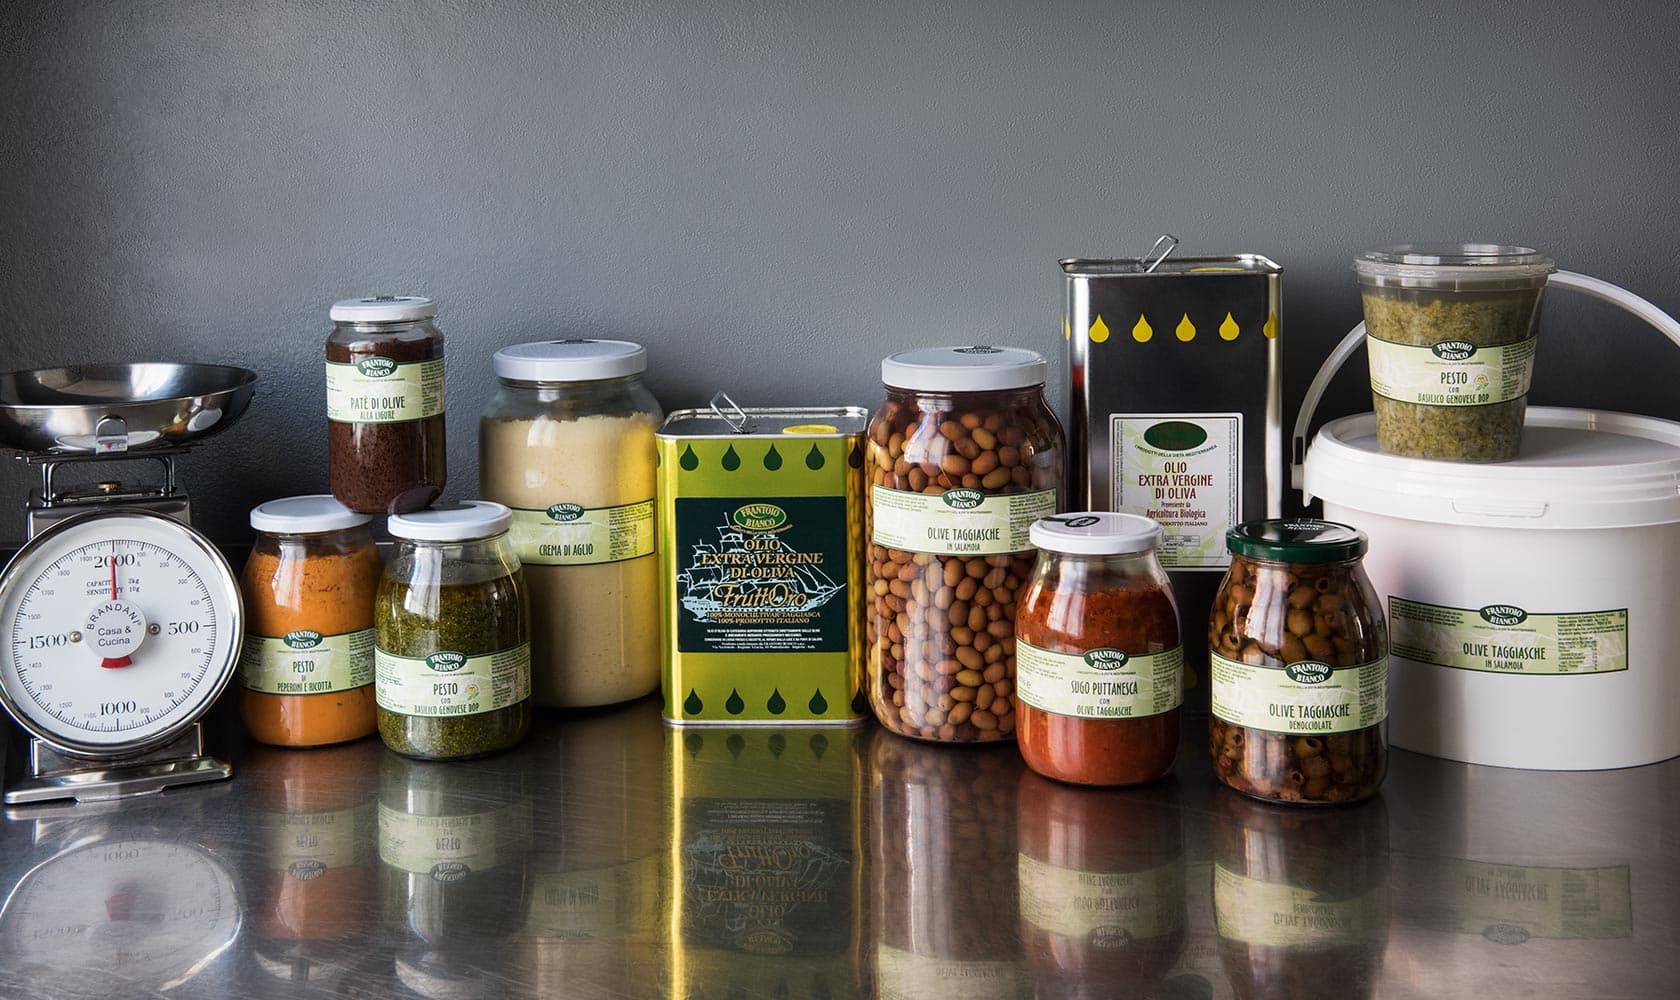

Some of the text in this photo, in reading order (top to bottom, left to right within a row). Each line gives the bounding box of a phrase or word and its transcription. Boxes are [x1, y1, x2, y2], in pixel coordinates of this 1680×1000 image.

[1436, 340, 1473, 352] FRANTOIO
[1441, 351, 1469, 361] BIANCO
[365, 368, 390, 377] BIANCO
[1440, 371, 1468, 384] PESTO
[371, 397, 379, 410] DI
[382, 396, 405, 409] OLIVE
[1418, 393, 1445, 404] BASILICO
[1446, 394, 1476, 404] GENOVESE
[360, 410, 395, 420] ALLA LIGURE
[1164, 462, 1187, 473] OLIO
[1138, 475, 1213, 486] EXTRA VERGINE
[947, 490, 982, 501] FRANTOIO
[1155, 488, 1196, 499] DI OLIVA
[551, 503, 581, 513] FRANTOIO
[951, 500, 977, 508] BIANCO
[554, 513, 577, 521] BIANCO
[740, 506, 780, 518] FRANTOIO
[1146, 508, 1206, 520] Agricoltura Biologica
[745, 518, 776, 529] BIANCO
[927, 527, 1000, 541] OLIVE TAGGIASCHE
[539, 543, 594, 557] CREMA DI AGLIO
[743, 539, 781, 551] OLIO
[954, 543, 981, 551] SALAMOIA
[94, 553, 135, 568] 2000
[701, 552, 824, 565] EXTRA VERGINE
[730, 567, 796, 579] DI OLIVA
[86, 603, 140, 630] BRANDANI
[1485, 606, 1522, 618] FRANTOIO
[1489, 615, 1519, 625] BIANCO
[98, 626, 131, 636] Casa &
[168, 622, 199, 635] 500
[29, 635, 67, 649] 1500
[98, 638, 130, 647] Cucina
[291, 640, 316, 649] BIANCO
[1090, 650, 1125, 661] FRANTOIO
[1463, 642, 1546, 660] OLIVE TAGGIASCHE
[430, 653, 463, 663] FRANTOIO
[293, 660, 315, 673] PESTO
[434, 662, 460, 672] BIANCO
[1093, 660, 1121, 670] BIANCO
[1291, 663, 1329, 674] FRANTOIO
[1485, 659, 1524, 670] IN SALAMOIA
[1296, 673, 1325, 683] BIANCO
[277, 681, 332, 692] PEPERONI E RICOTTA
[433, 682, 458, 696] PESTO
[1071, 680, 1138, 695] SUGO PUTTANESCA
[100, 700, 136, 715] 1000
[414, 703, 480, 714] BASILICO GENOVESE DOP
[1077, 705, 1132, 716] OLIVE TAGGIASCHE
[1269, 703, 1350, 718] OLIVE TAGGIASCHE
[1289, 720, 1332, 730] DENOCCIOLATE
